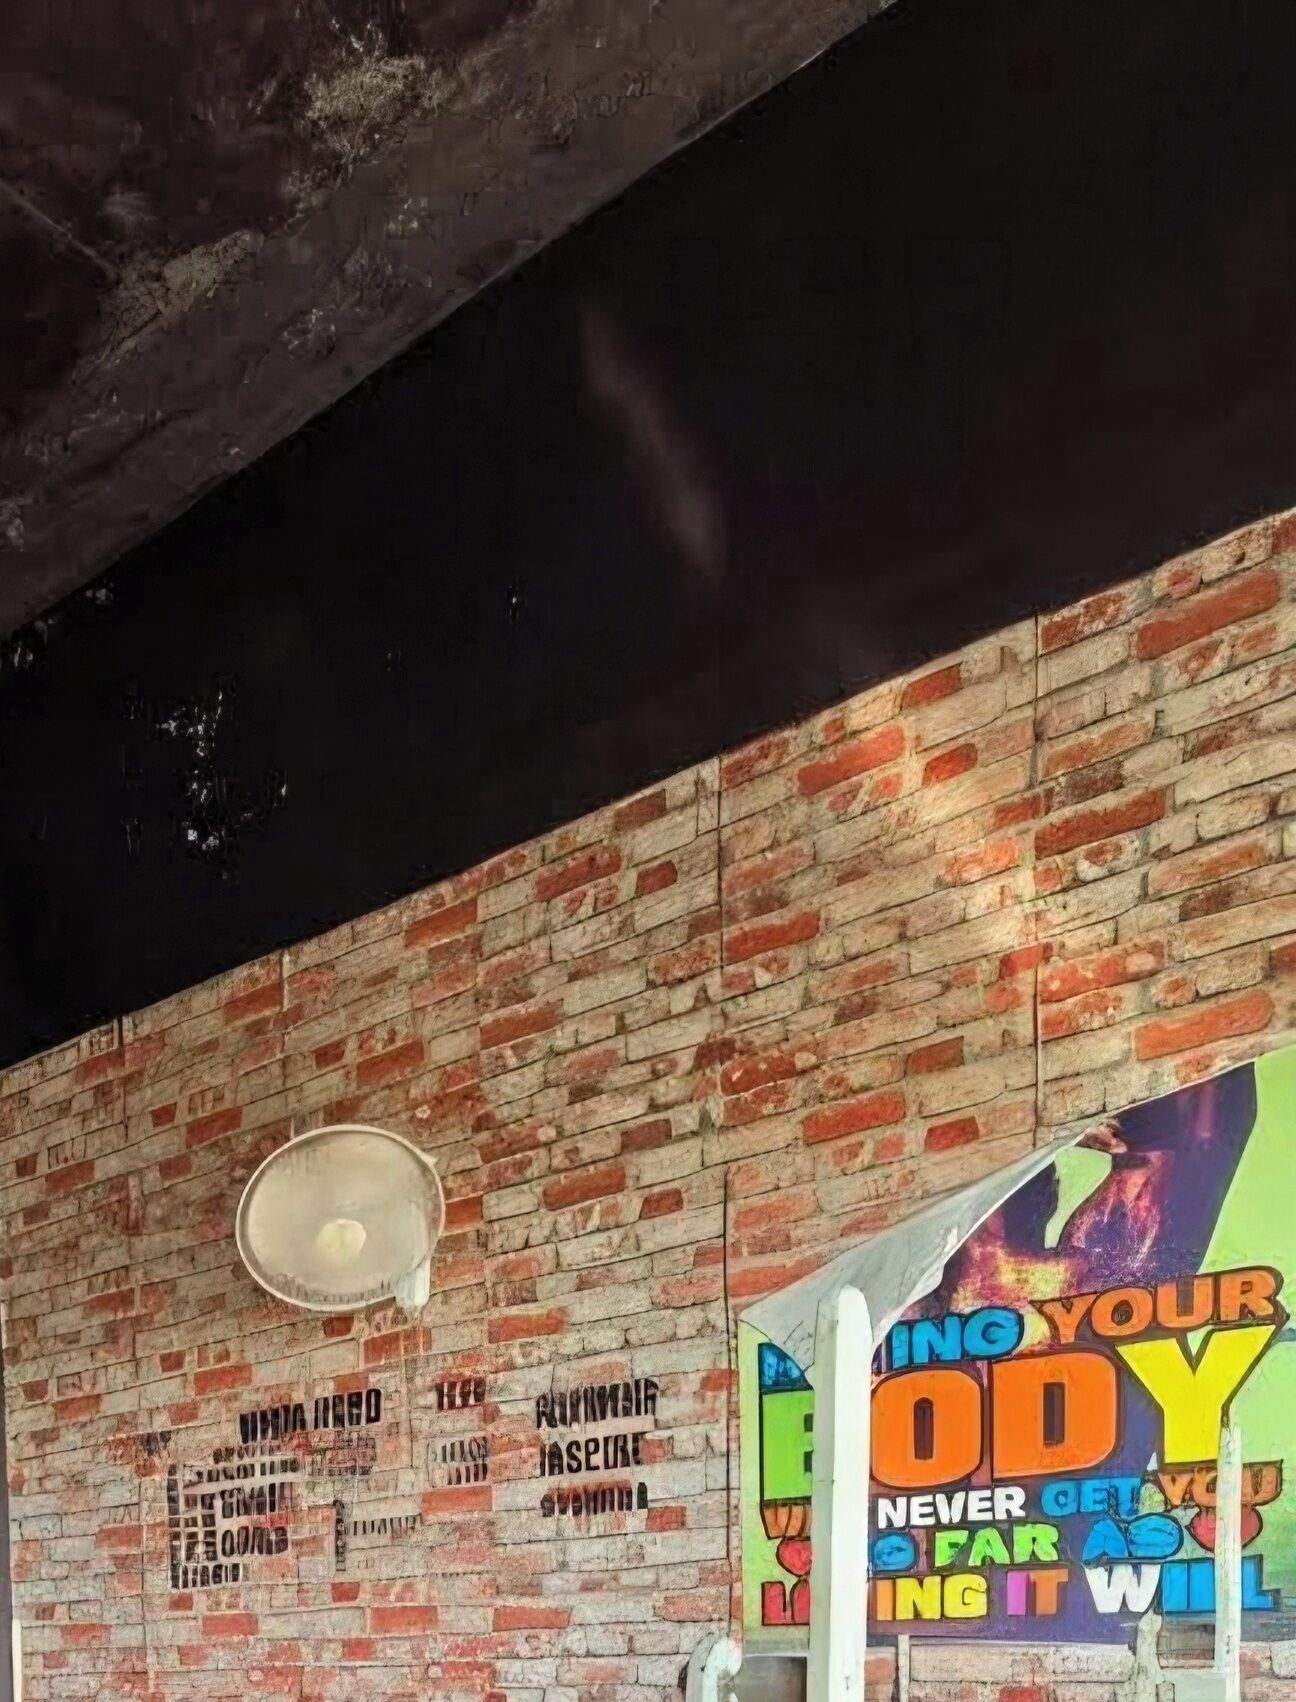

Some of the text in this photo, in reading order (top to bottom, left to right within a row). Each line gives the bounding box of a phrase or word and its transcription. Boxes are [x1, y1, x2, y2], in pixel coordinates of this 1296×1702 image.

[1031, 1266, 1281, 1343] YOUR
[877, 1486, 1026, 1529] NEVER
[933, 1522, 1059, 1567] FAR
[1007, 1569, 1068, 1617] IT
